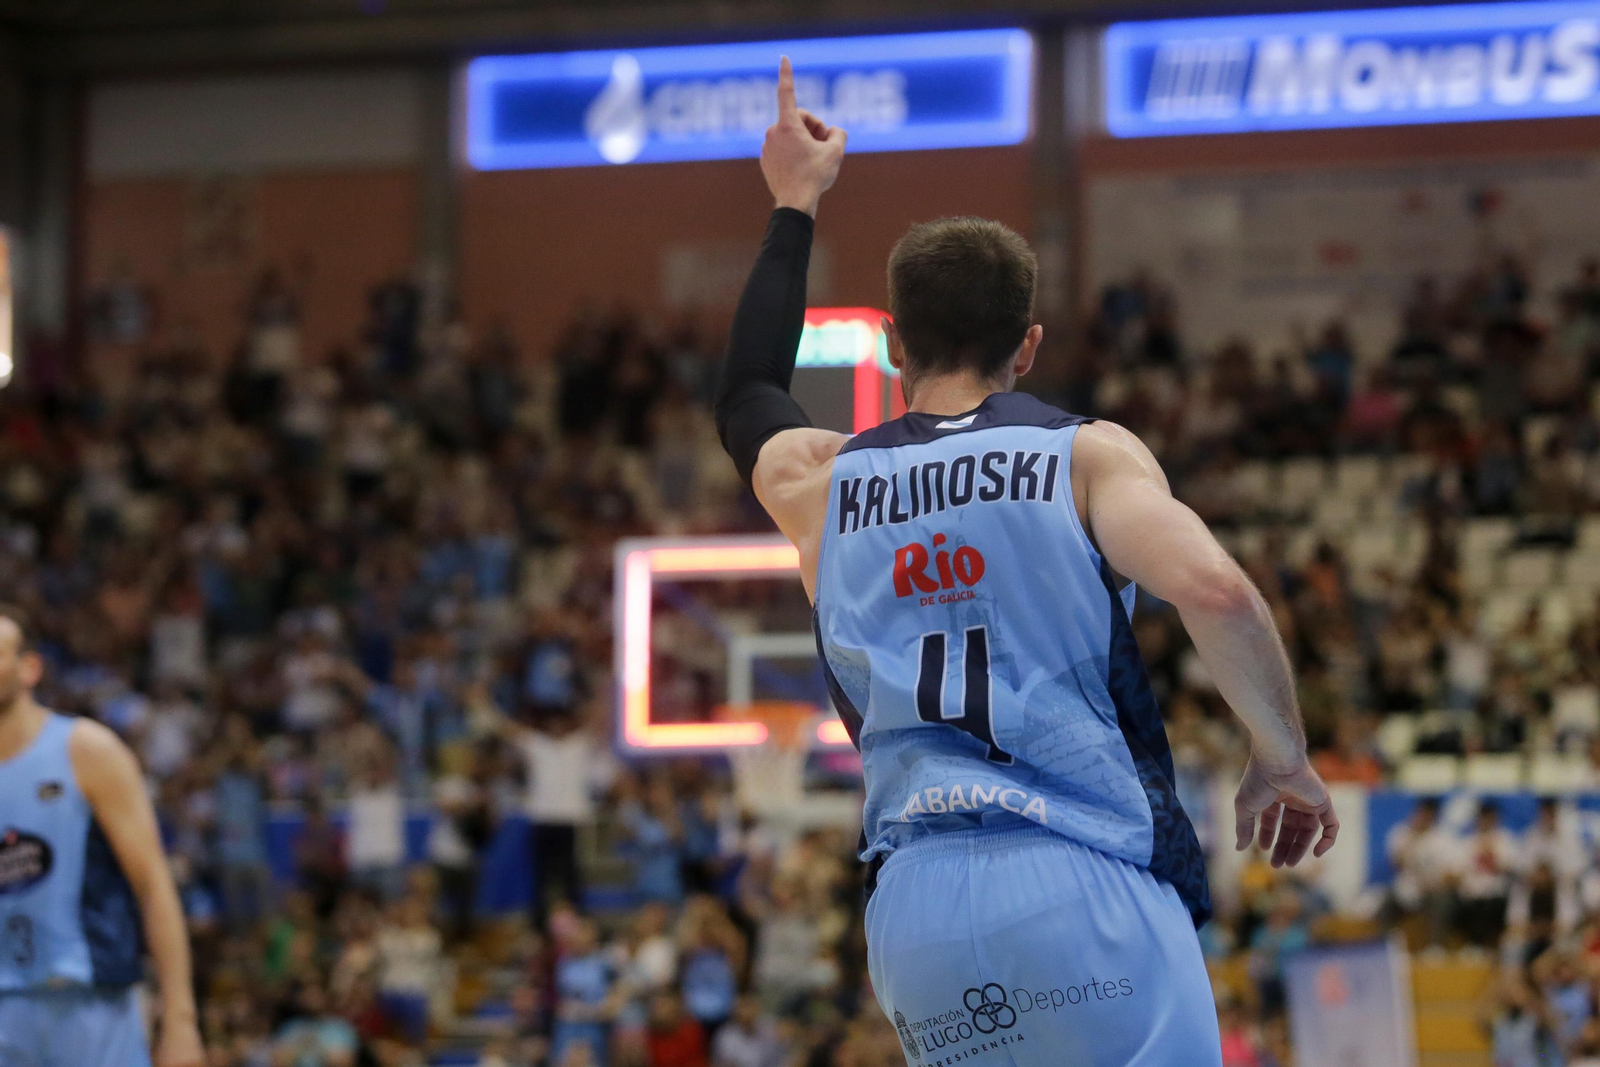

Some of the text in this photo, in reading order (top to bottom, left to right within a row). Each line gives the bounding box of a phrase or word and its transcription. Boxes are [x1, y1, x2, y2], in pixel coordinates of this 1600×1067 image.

[838, 450, 1060, 537] KALINOSKI
[920, 590, 976, 607] DE GALICIA
[914, 624, 1014, 766] 4
[901, 784, 1048, 824] ABANCA
[1012, 977, 1133, 1013] Deportes
[922, 1022, 973, 1053] LUGO
